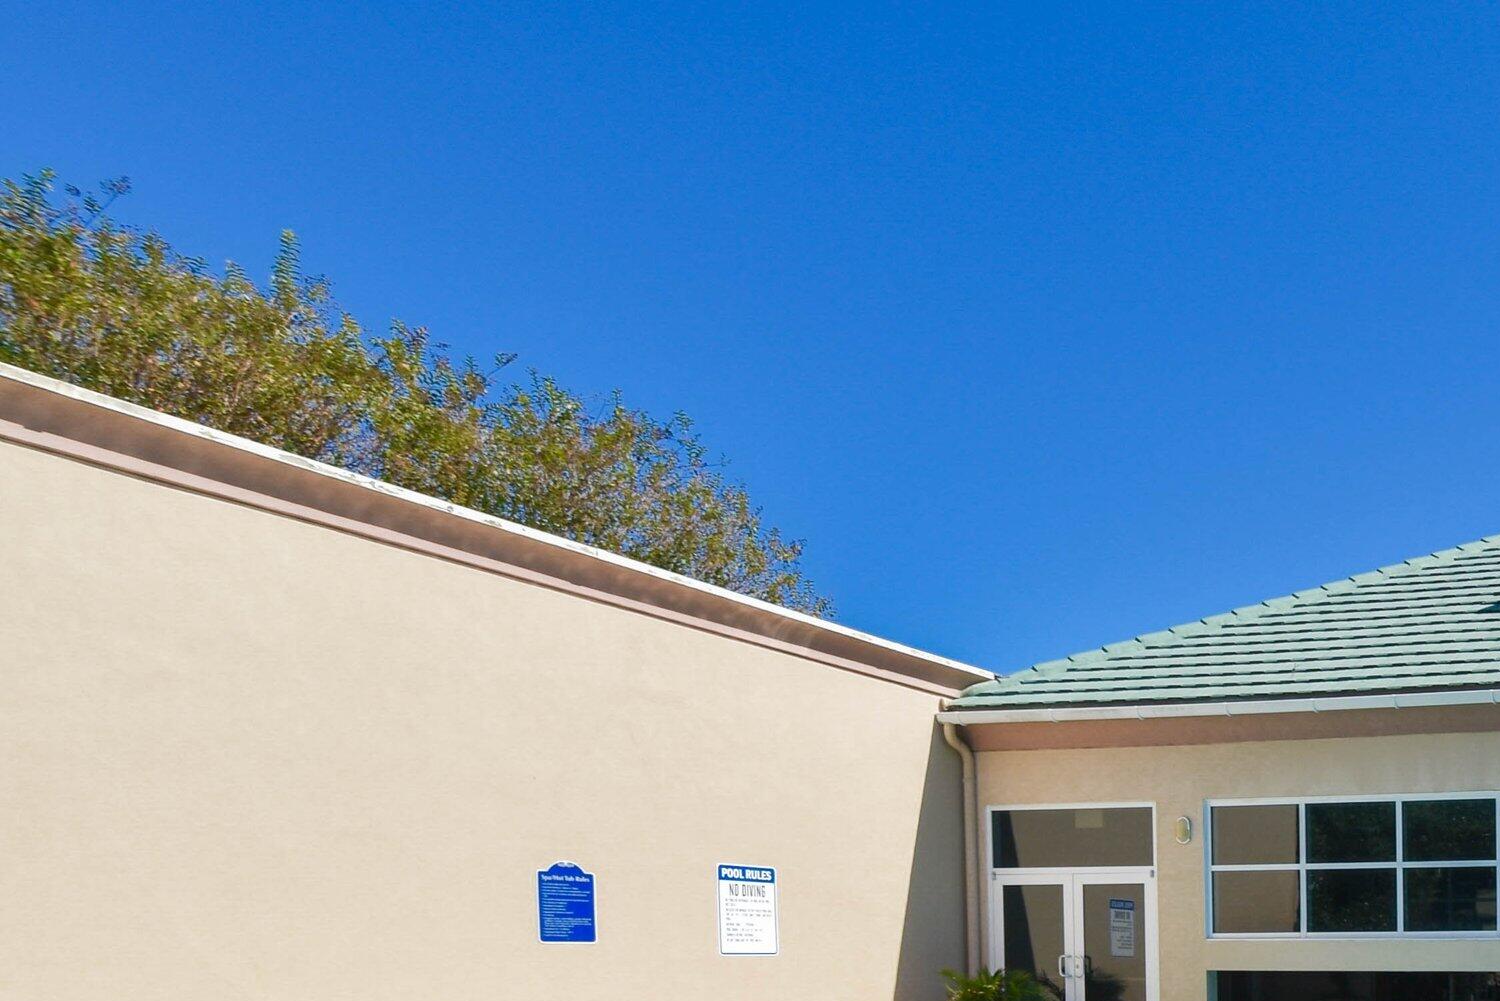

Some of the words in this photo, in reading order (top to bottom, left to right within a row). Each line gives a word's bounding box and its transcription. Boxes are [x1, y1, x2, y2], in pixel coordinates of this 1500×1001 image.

[721, 867, 744, 879] POOL
[745, 869, 772, 881] RULES
[729, 884, 739, 897] NO
[742, 884, 766, 897] DIVING
